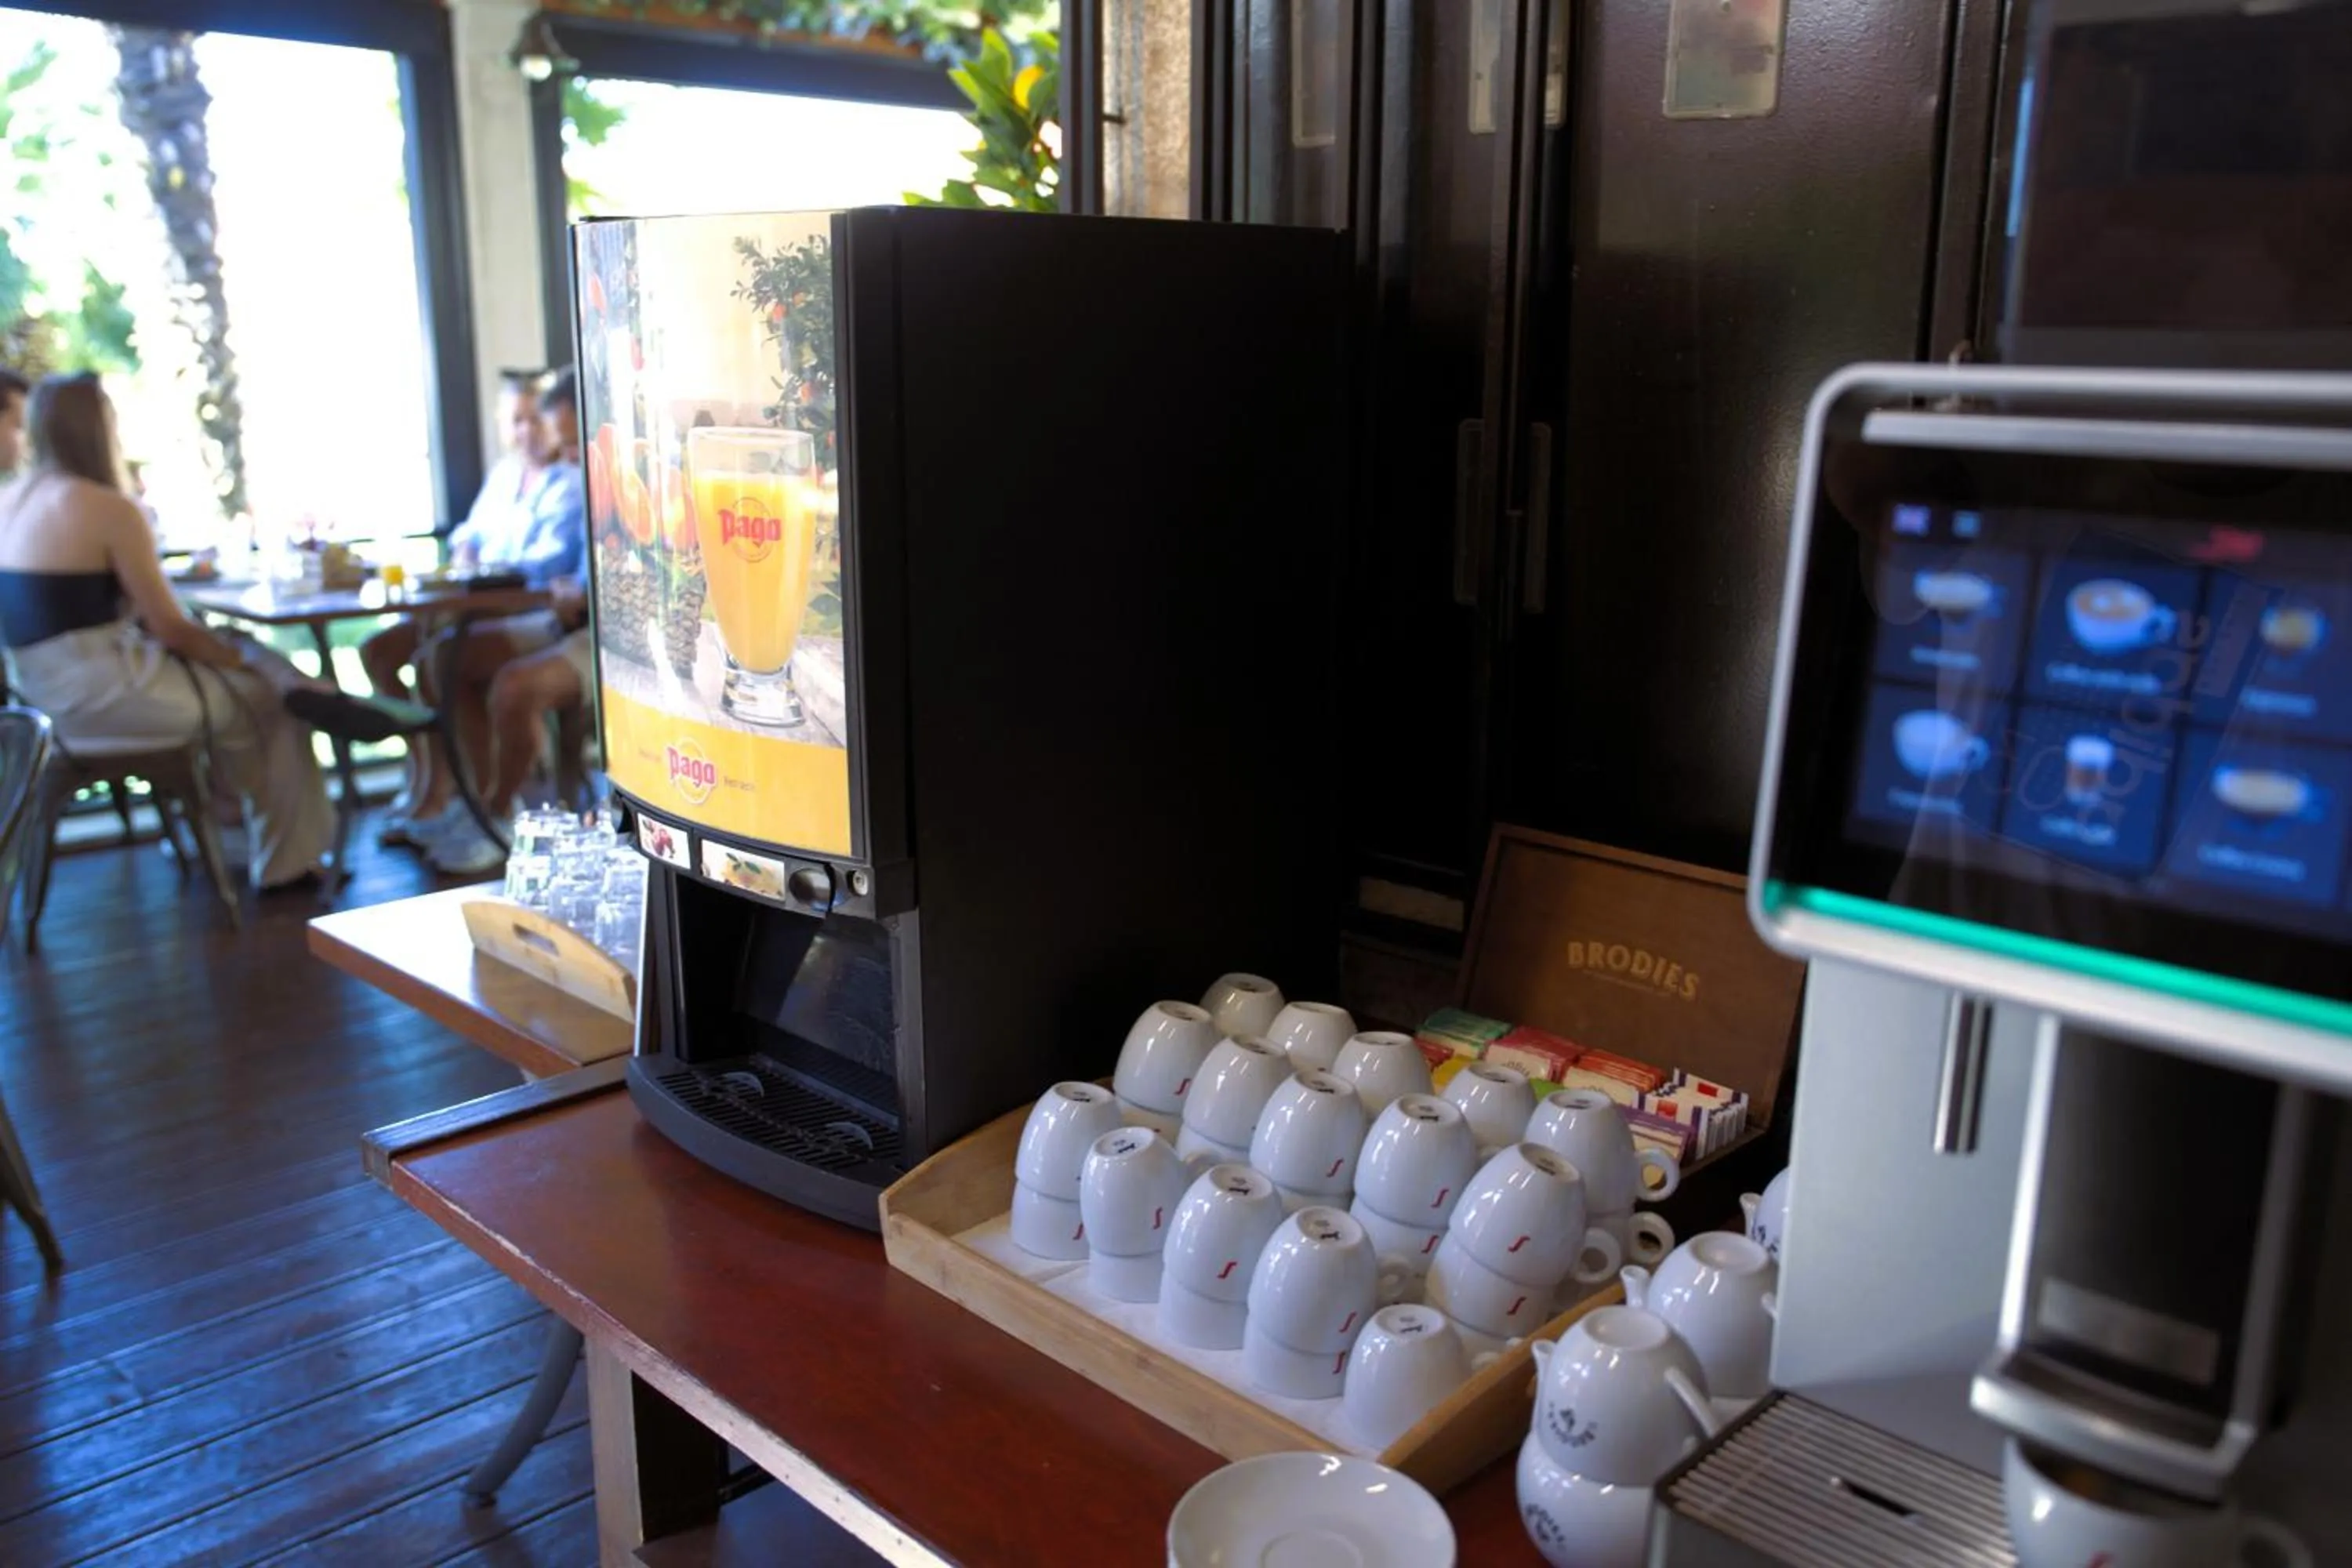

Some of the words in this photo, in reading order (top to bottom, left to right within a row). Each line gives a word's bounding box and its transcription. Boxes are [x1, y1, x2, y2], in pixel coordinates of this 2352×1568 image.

[717, 508, 782, 549] pago
[667, 746, 715, 787] pago
[1568, 942, 1699, 1000] BRODIES
